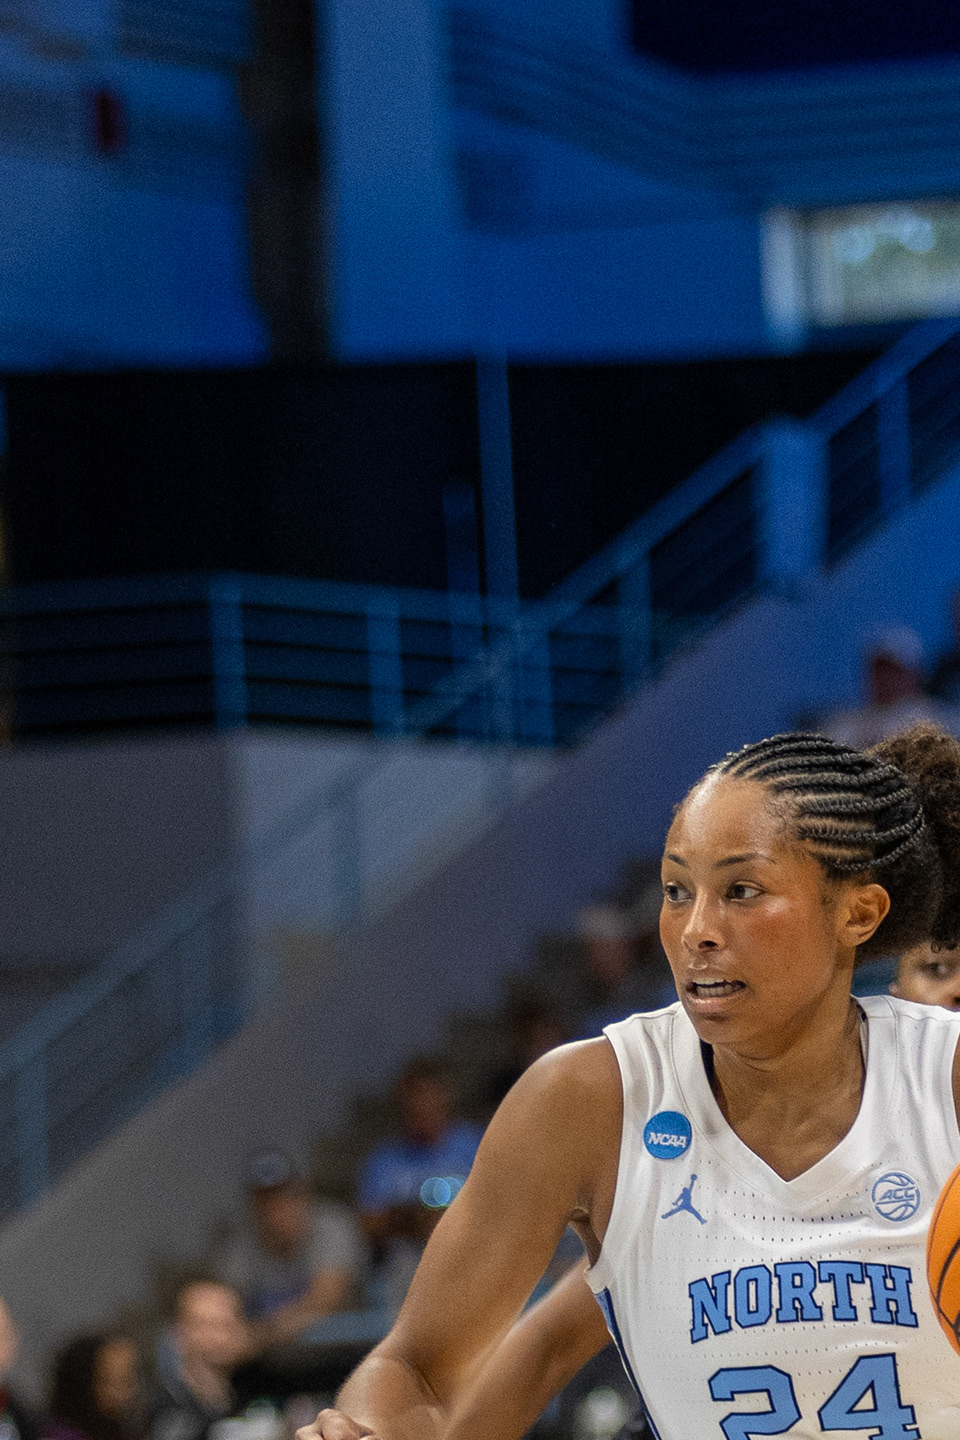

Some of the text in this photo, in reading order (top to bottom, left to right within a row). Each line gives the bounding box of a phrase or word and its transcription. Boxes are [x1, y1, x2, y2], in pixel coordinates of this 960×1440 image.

[647, 1131, 688, 1149] NCAA
[879, 1186, 915, 1201] ACC
[688, 1260, 919, 1344] NORTH
